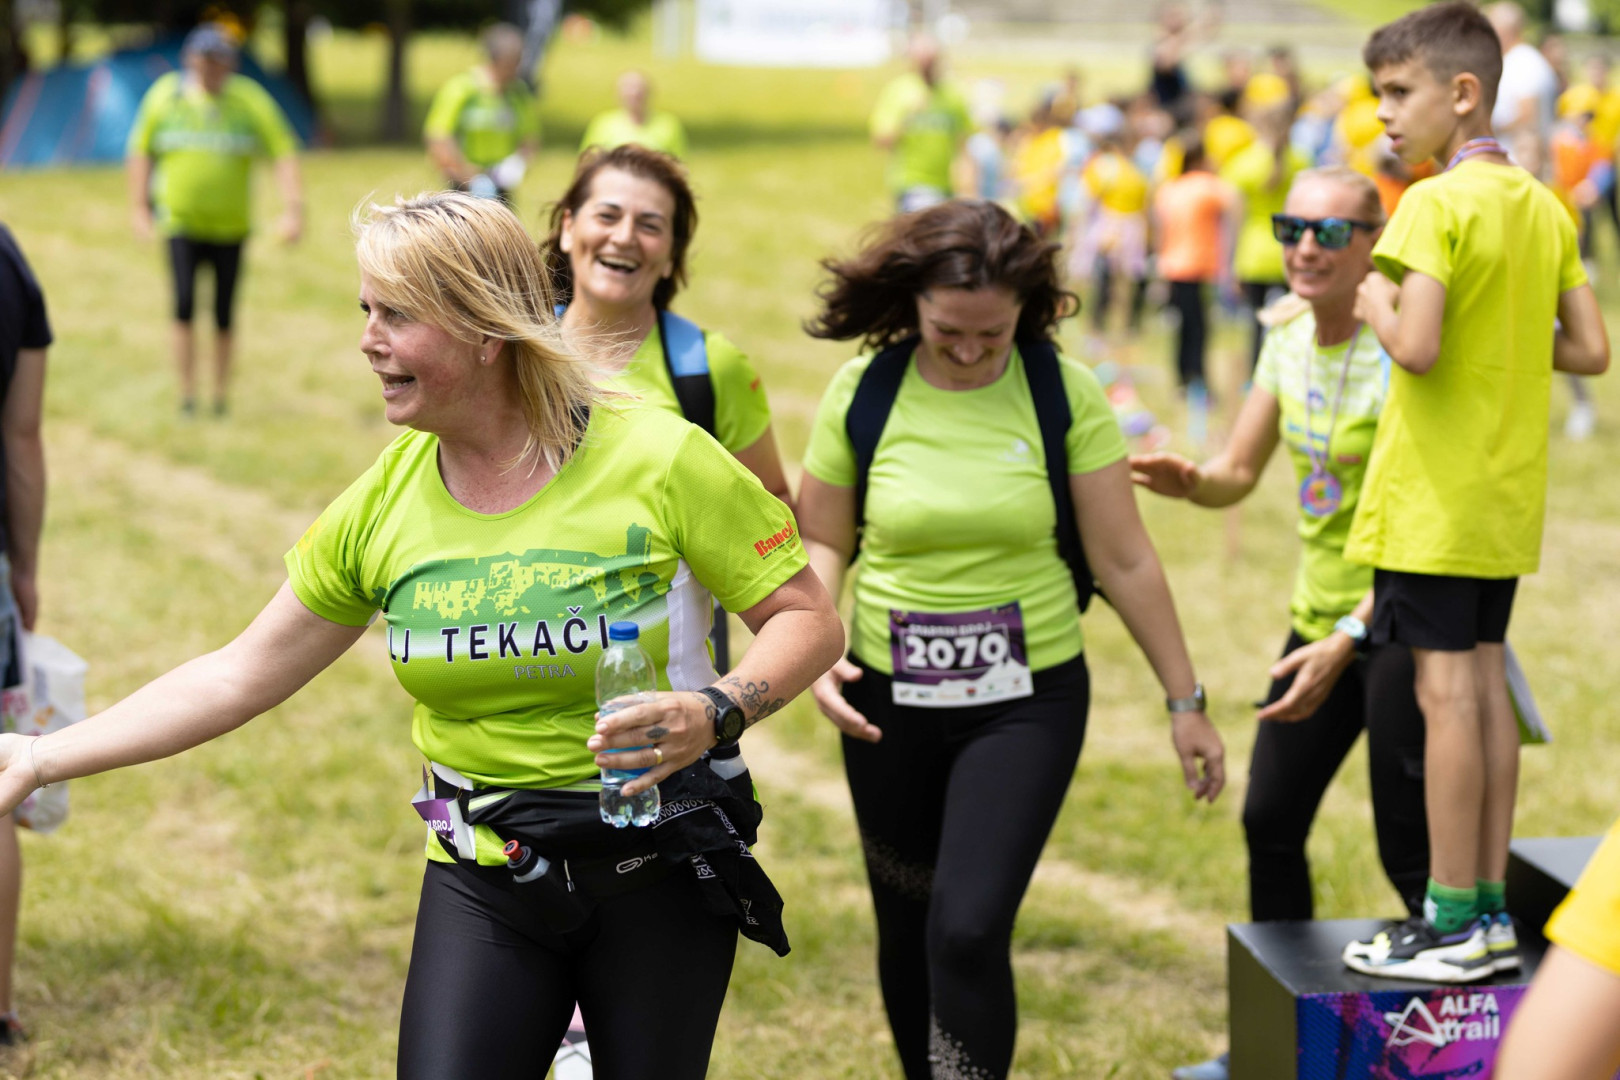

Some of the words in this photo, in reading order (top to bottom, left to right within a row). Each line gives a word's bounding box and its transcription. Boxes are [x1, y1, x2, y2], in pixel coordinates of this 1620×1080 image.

[440, 605, 609, 663] TEKAČI
[906, 632, 1009, 669] 2070
[514, 663, 577, 680] PETRA
[1439, 993, 1499, 1016] ALFA
[1438, 1015, 1499, 1041] trail
